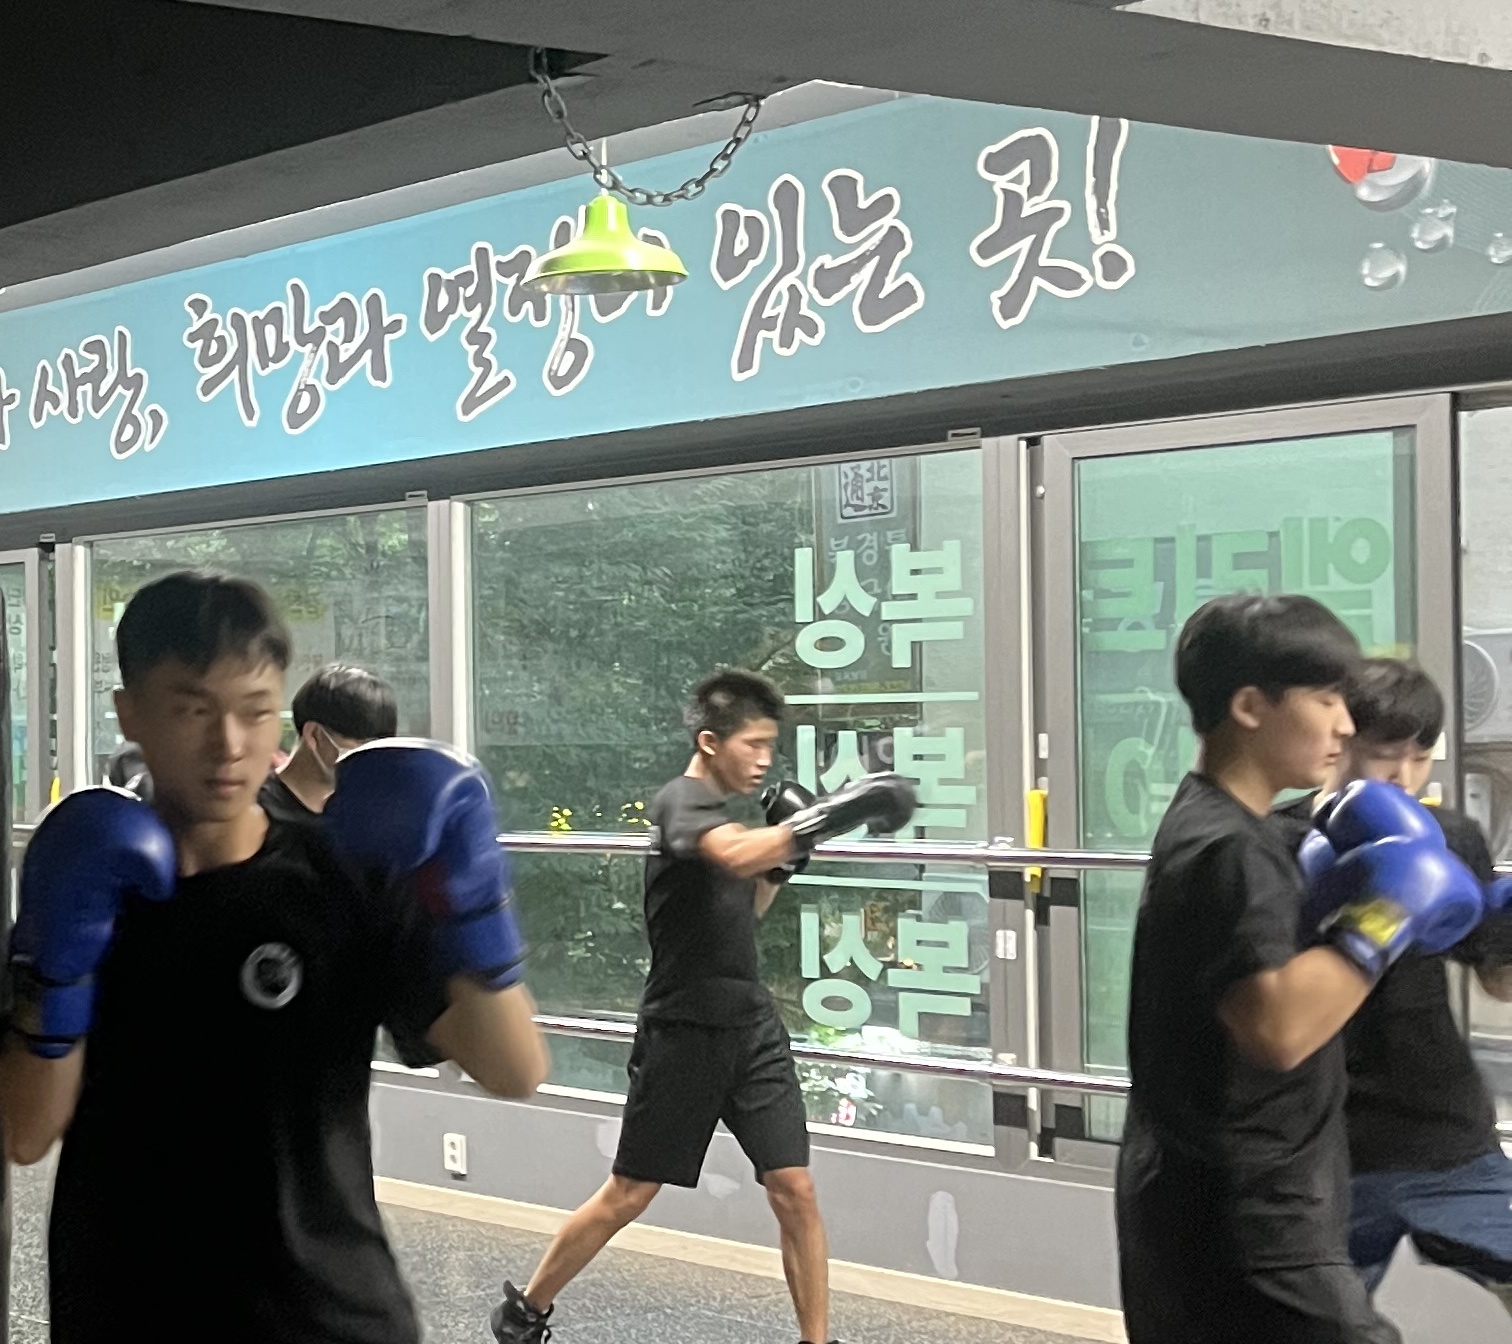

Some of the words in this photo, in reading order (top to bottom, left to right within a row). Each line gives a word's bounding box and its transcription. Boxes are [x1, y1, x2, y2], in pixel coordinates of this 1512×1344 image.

[30, 325, 168, 460] 사랑,
[183, 277, 407, 435] 희망과
[711, 172, 925, 382] 있는
[970, 116, 1135, 330] 곳!
